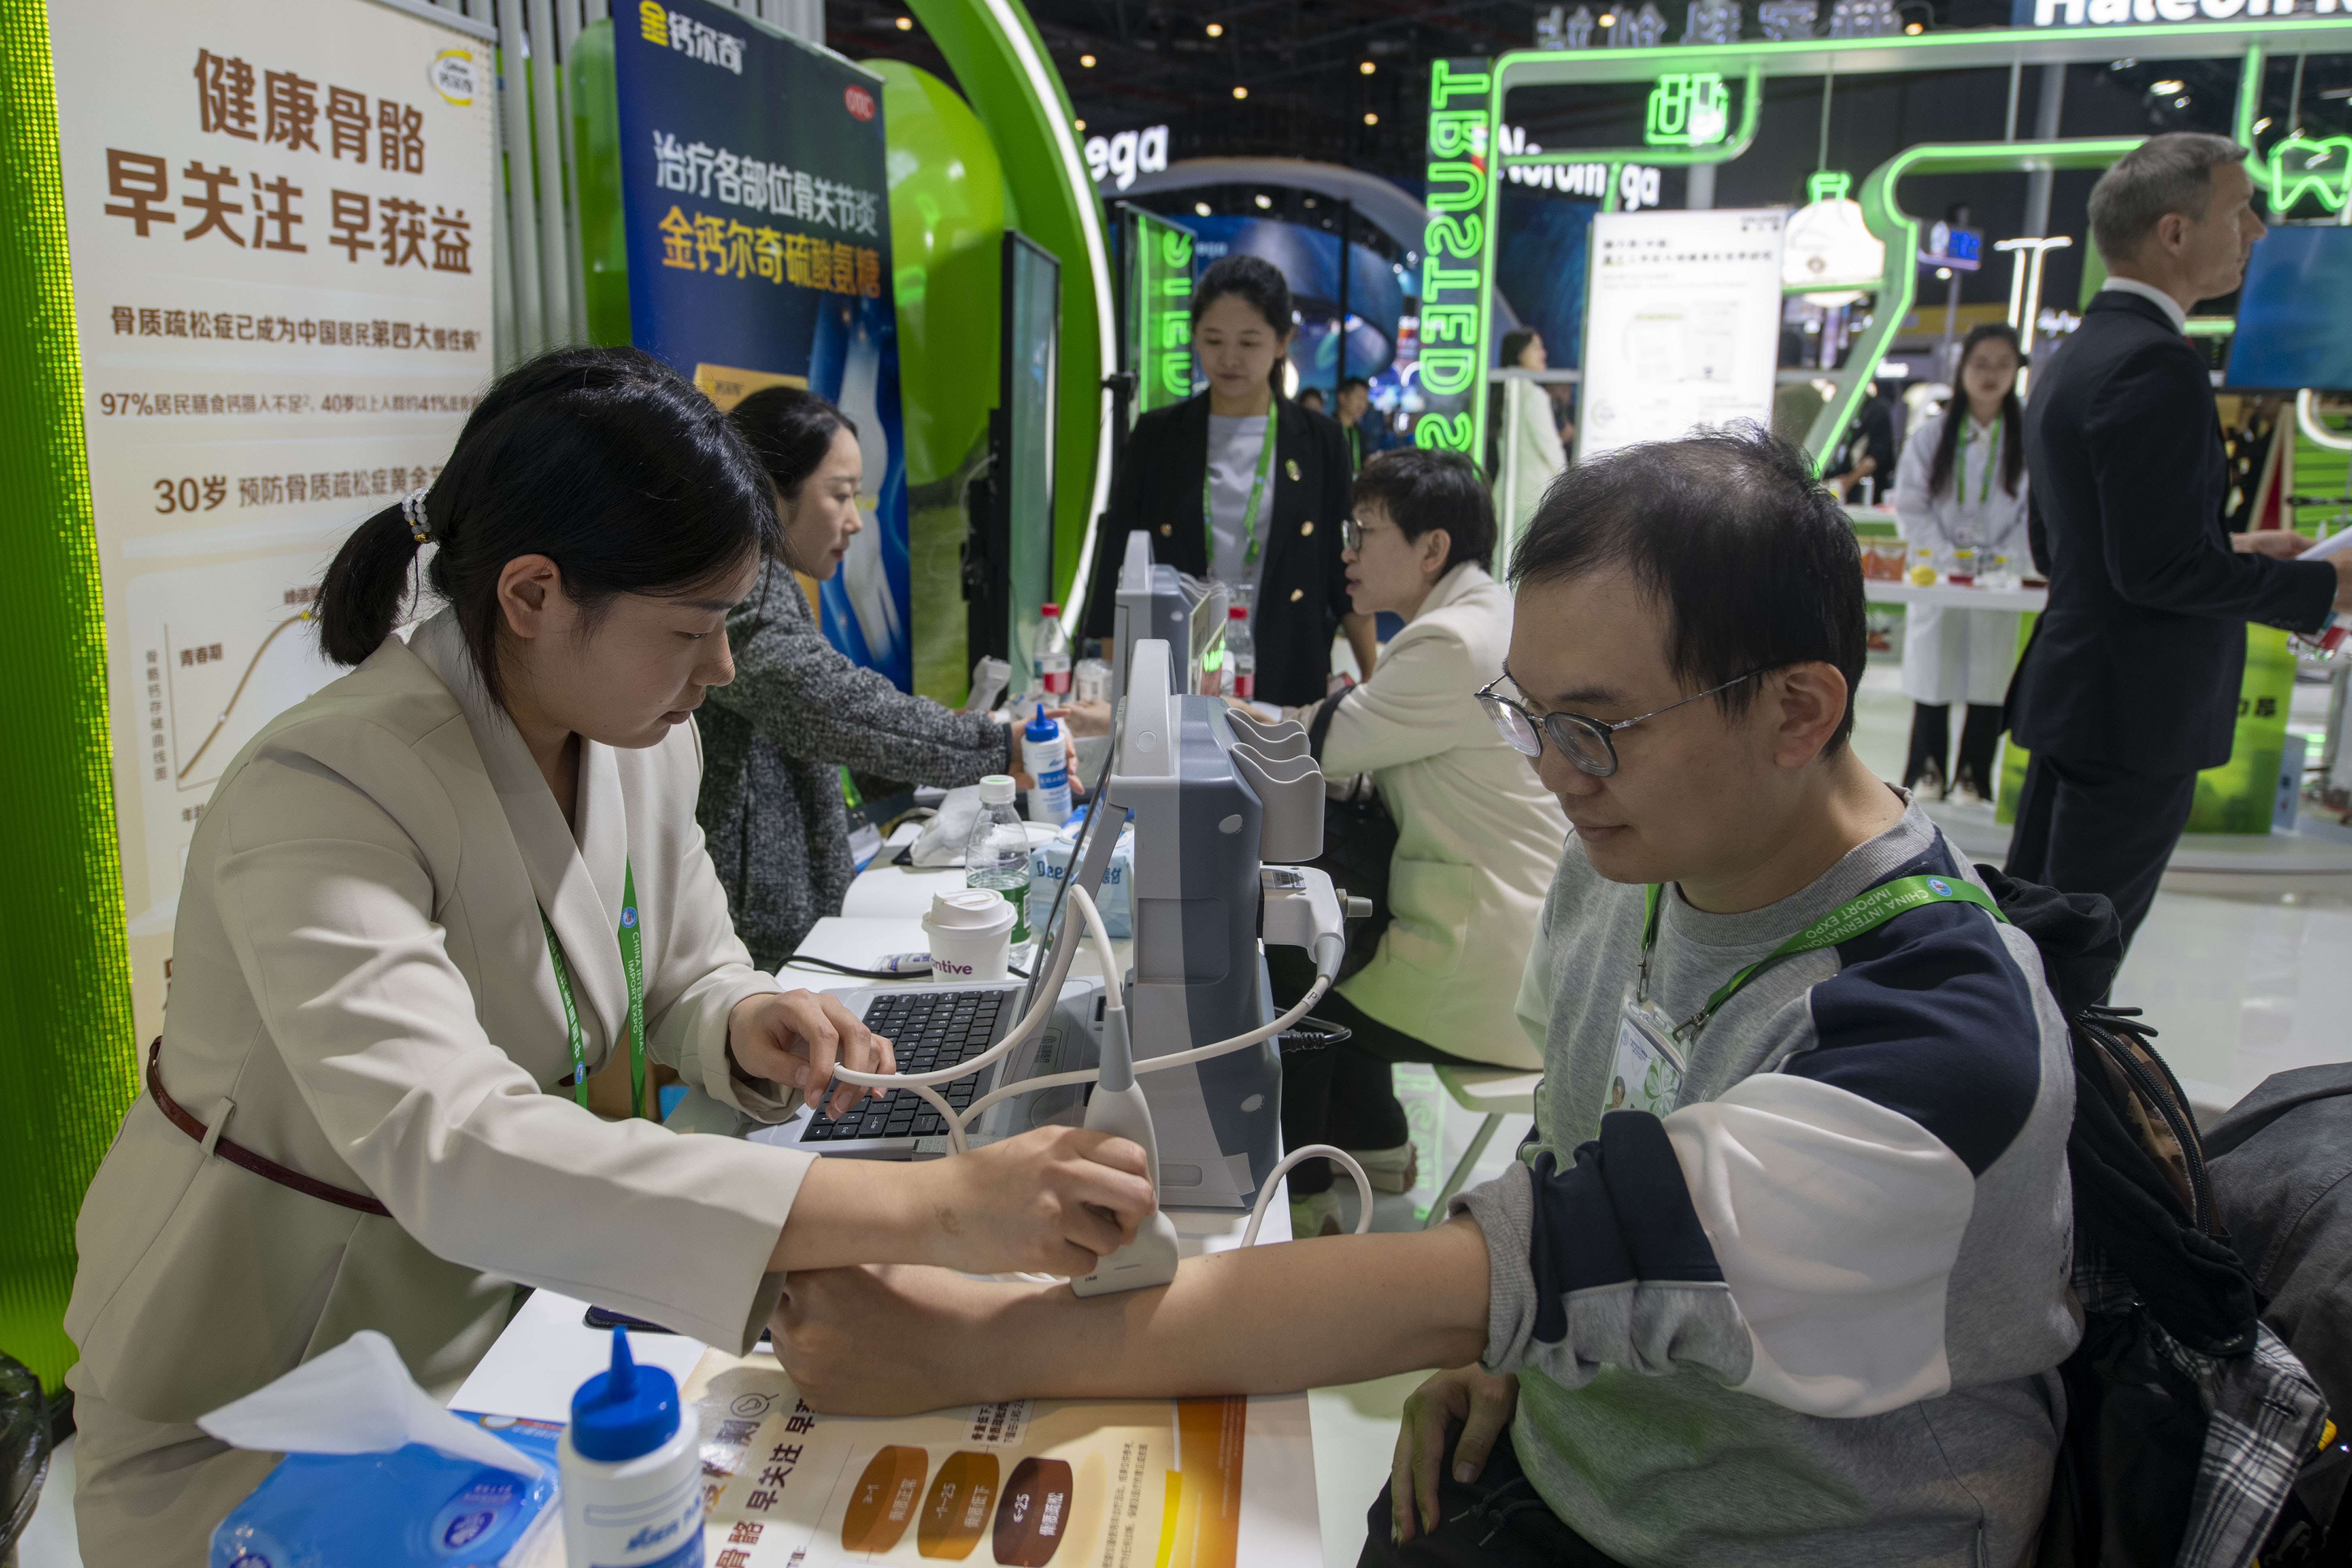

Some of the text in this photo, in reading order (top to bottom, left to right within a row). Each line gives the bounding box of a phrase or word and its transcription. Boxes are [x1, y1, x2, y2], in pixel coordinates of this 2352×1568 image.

[193, 47, 424, 175] 健康骨骼
[104, 147, 472, 275] 早关注 早获益
[653, 130, 879, 237] 治疗各部位骨关节炎
[154, 475, 228, 513] 30岁
[1805, 888, 1892, 939] IMPORT EXPO
[1884, 890, 1930, 910] CHINA
[628, 960, 637, 1001] IMPORT
[633, 932, 644, 1055] CHINA INTERNATIONAL
[746, 1443, 803, 1512] 早关注
